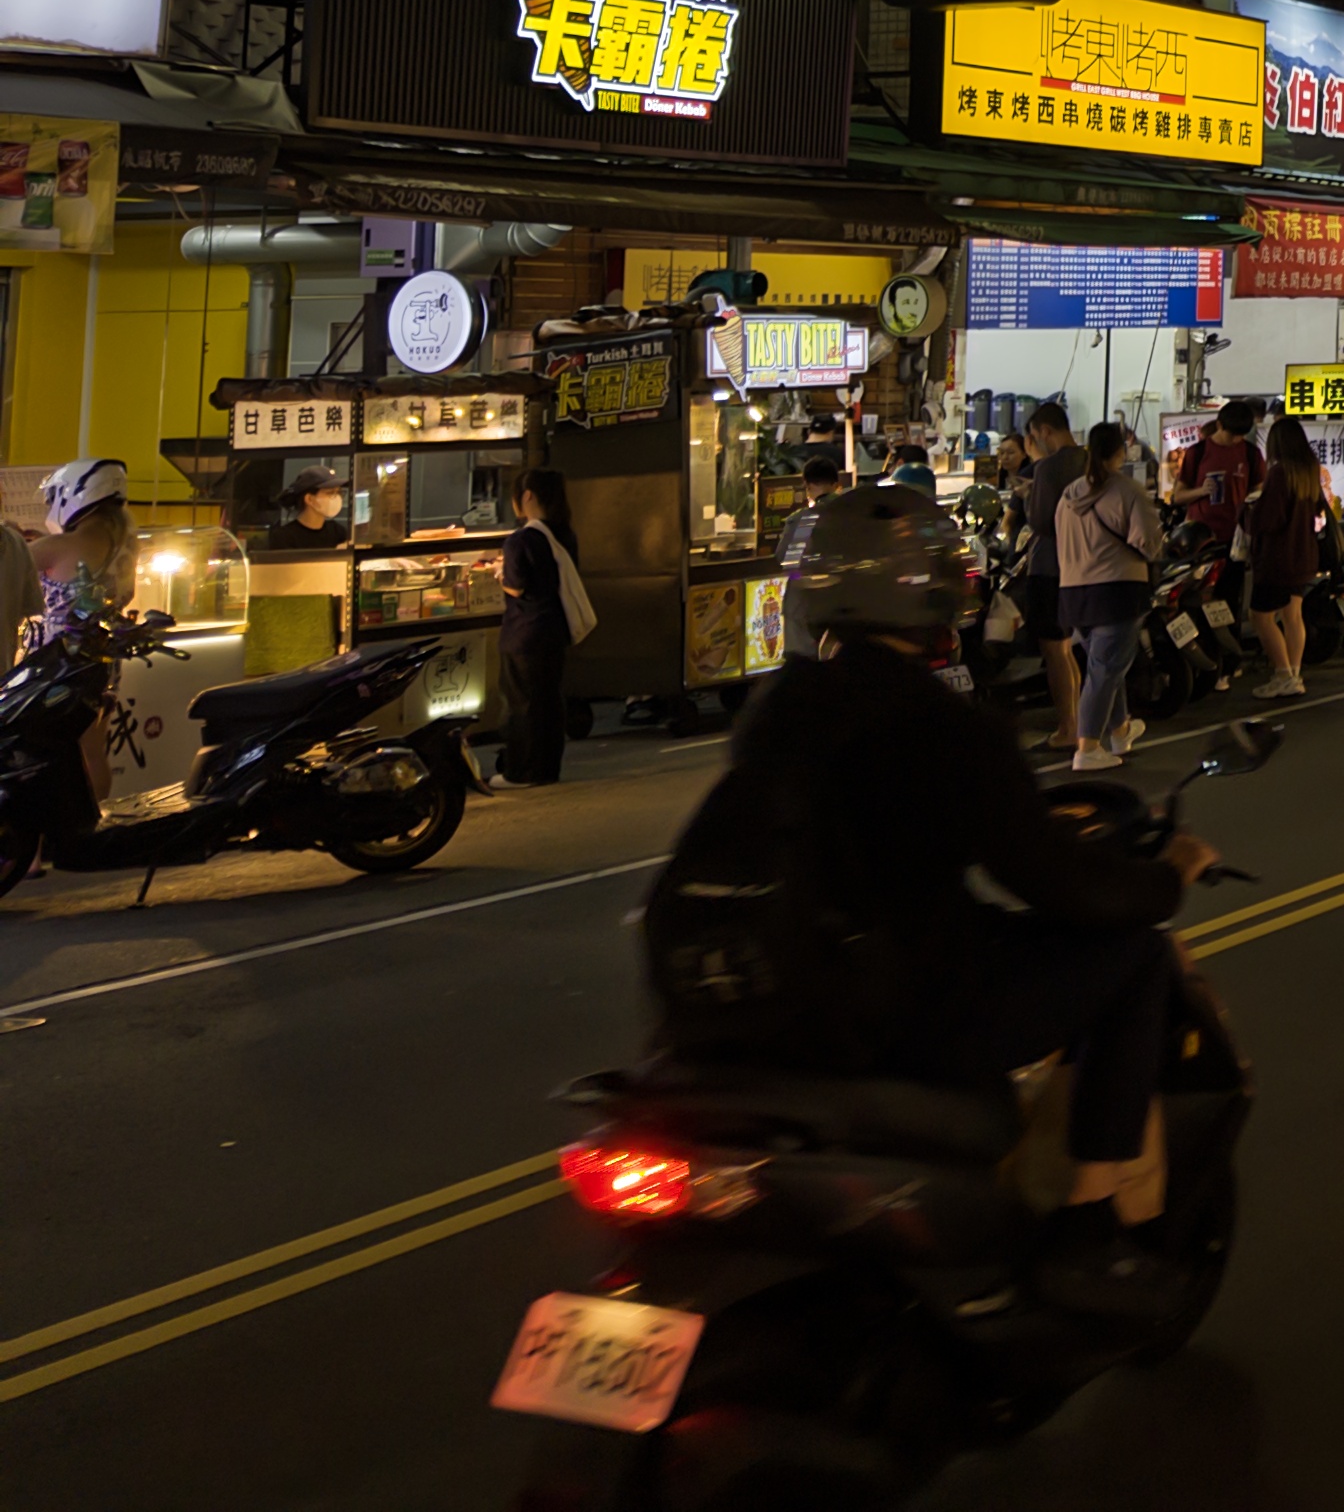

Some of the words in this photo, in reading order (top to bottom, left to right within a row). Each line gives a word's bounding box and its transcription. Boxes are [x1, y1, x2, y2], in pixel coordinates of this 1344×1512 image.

[957, 83, 1254, 148] 烤東烤西串燒碳烤雞排專賣店
[586, 348, 628, 365] Turkish
[746, 322, 796, 367] TASTY
[243, 405, 343, 435] 甘草芭樂
